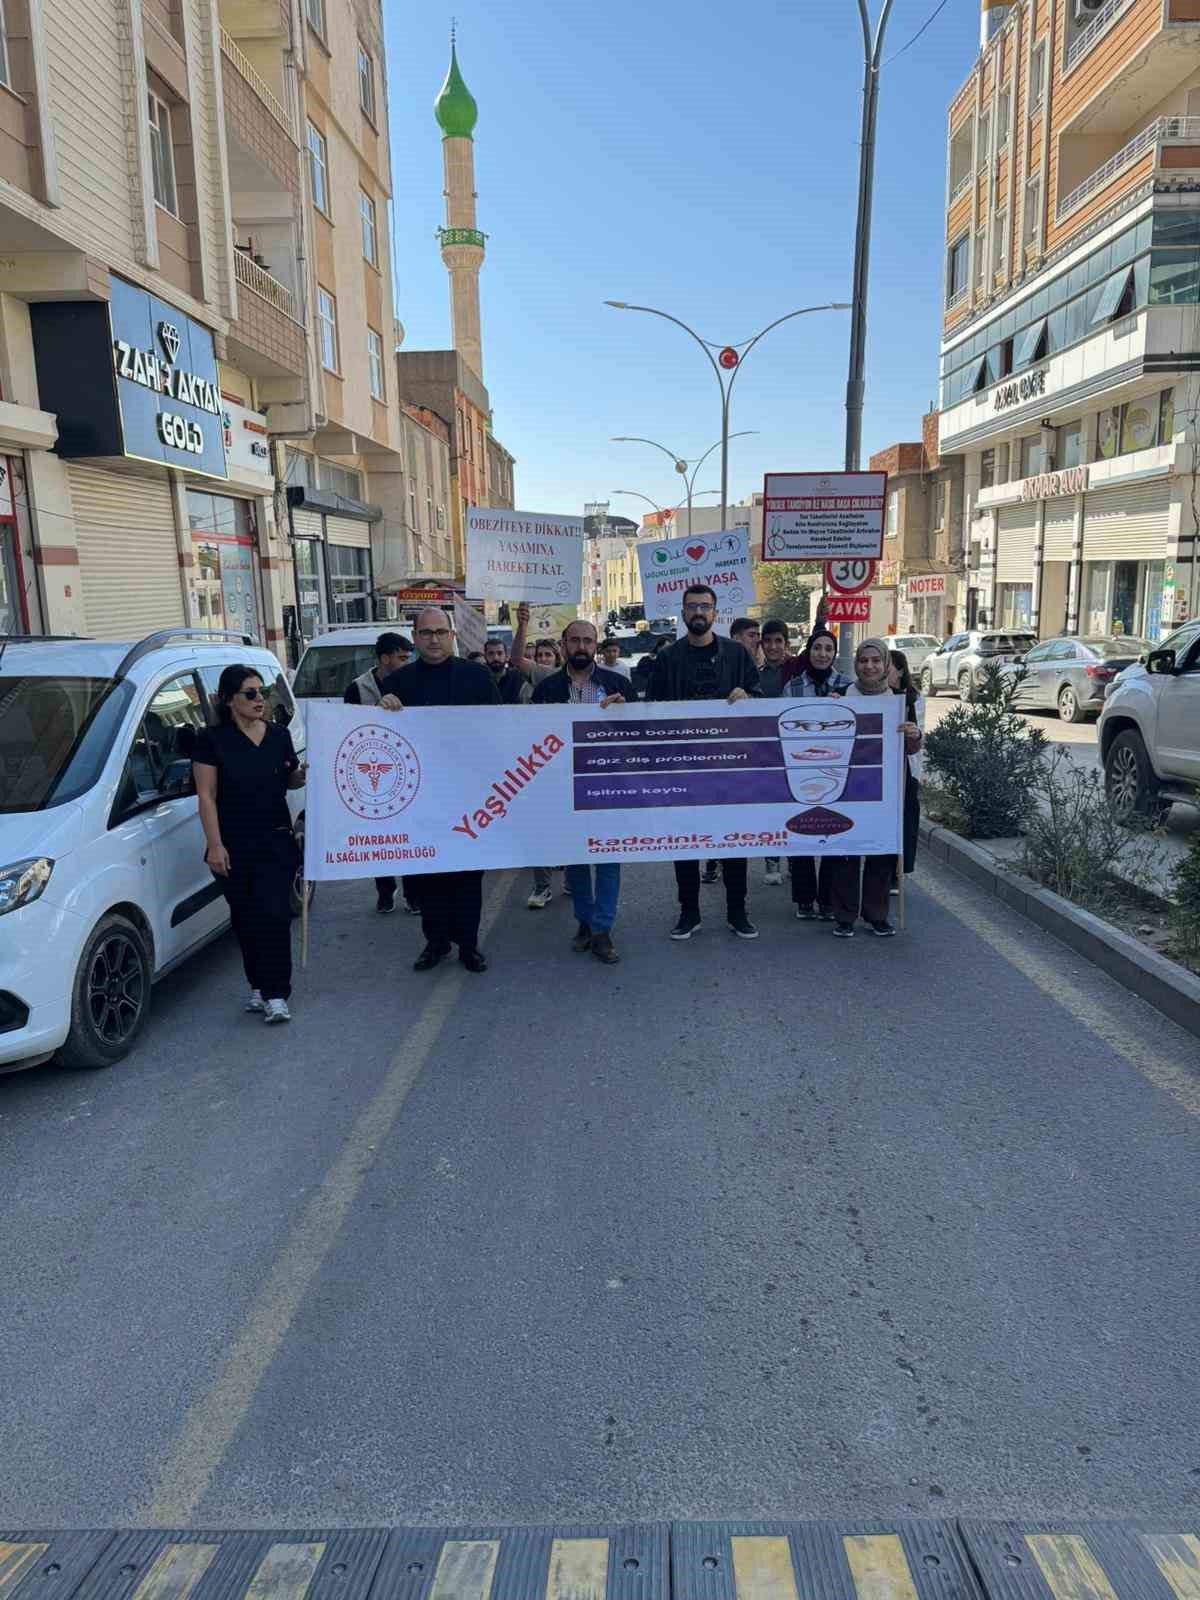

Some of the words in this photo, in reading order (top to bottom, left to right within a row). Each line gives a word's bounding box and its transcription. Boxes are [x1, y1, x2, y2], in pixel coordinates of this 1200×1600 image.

[177, 369, 222, 415] AKTAN
[160, 411, 204, 454] GOLD
[470, 517, 533, 534] OBEZİTEYE
[498, 540, 554, 556] YAŞAMINA
[488, 560, 537, 574] HAREKET
[835, 560, 866, 581] 30
[704, 571, 739, 586] YAŞA
[910, 577, 945, 593] NOTER
[586, 729, 640, 739] görme
[645, 726, 729, 737] bozukluğu
[586, 757, 622, 766] ağız
[655, 753, 747, 763] problemleri
[452, 734, 565, 840] Yaşlılıkta
[642, 786, 687, 795] kaybı
[348, 833, 409, 847] DİYARBAKIR
[588, 834, 712, 847] kaderiniz
[325, 851, 335, 864] İL
[336, 850, 370, 863] SAĞLIK
[371, 846, 436, 861] MÜDÜRLÜĞÜ
[588, 843, 700, 854] doktorunuza
